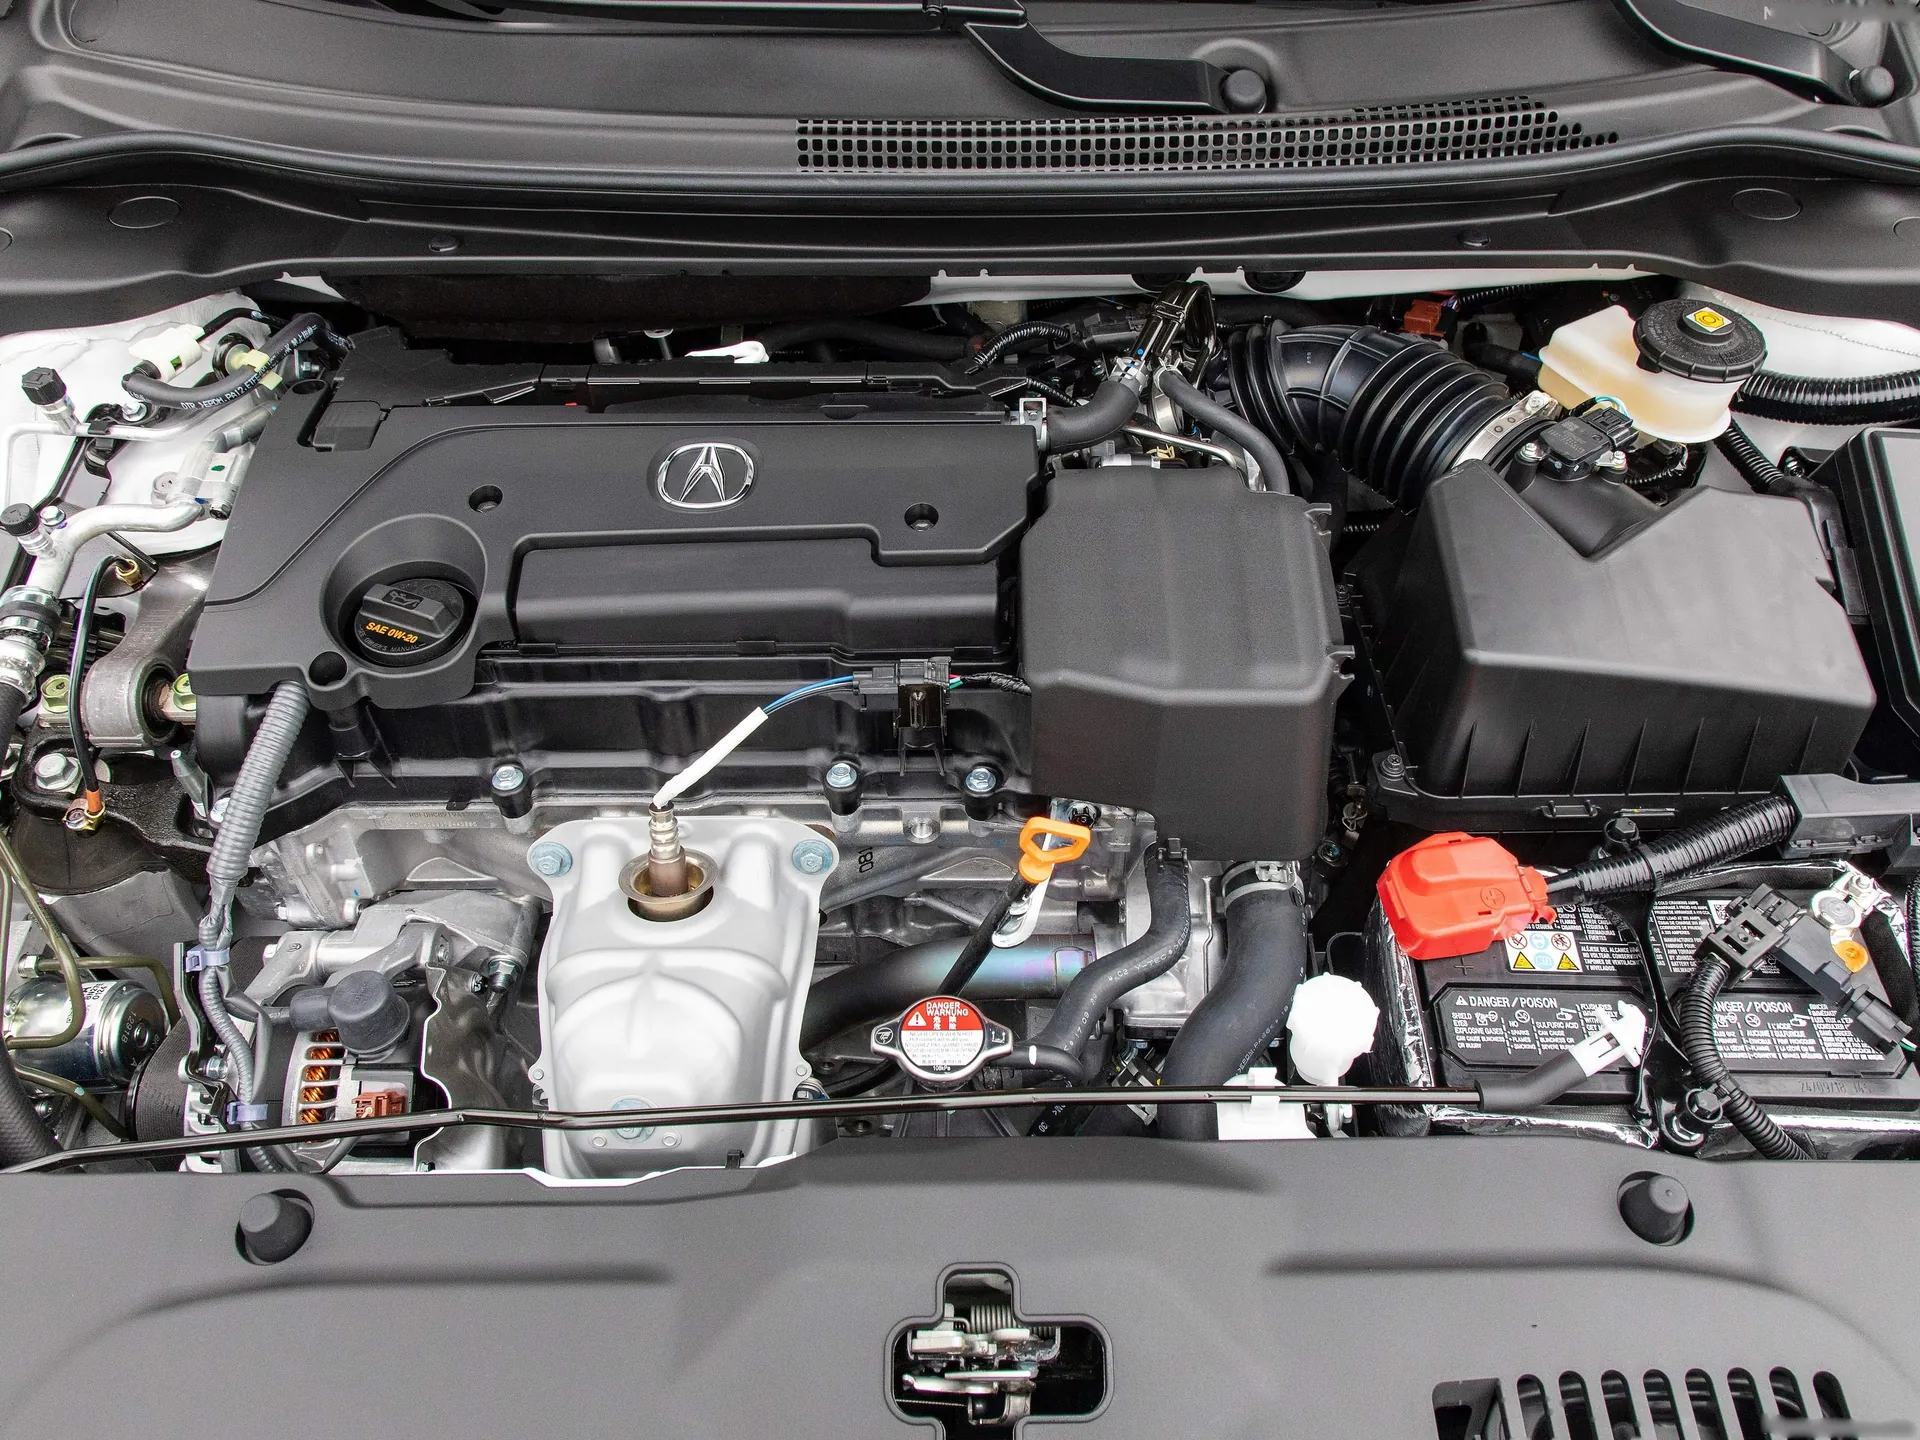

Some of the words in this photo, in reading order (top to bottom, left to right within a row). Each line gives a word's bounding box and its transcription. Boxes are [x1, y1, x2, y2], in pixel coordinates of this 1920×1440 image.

[365, 622, 389, 634] SAE
[387, 628, 418, 644] 0W-20
[1469, 996, 1510, 1008] DANGER
[1519, 997, 1558, 1008] POISON
[1713, 1002, 1745, 1012] ANGER
[1754, 1002, 1793, 1012] POISON
[1451, 1012, 1472, 1020] SHIELD
